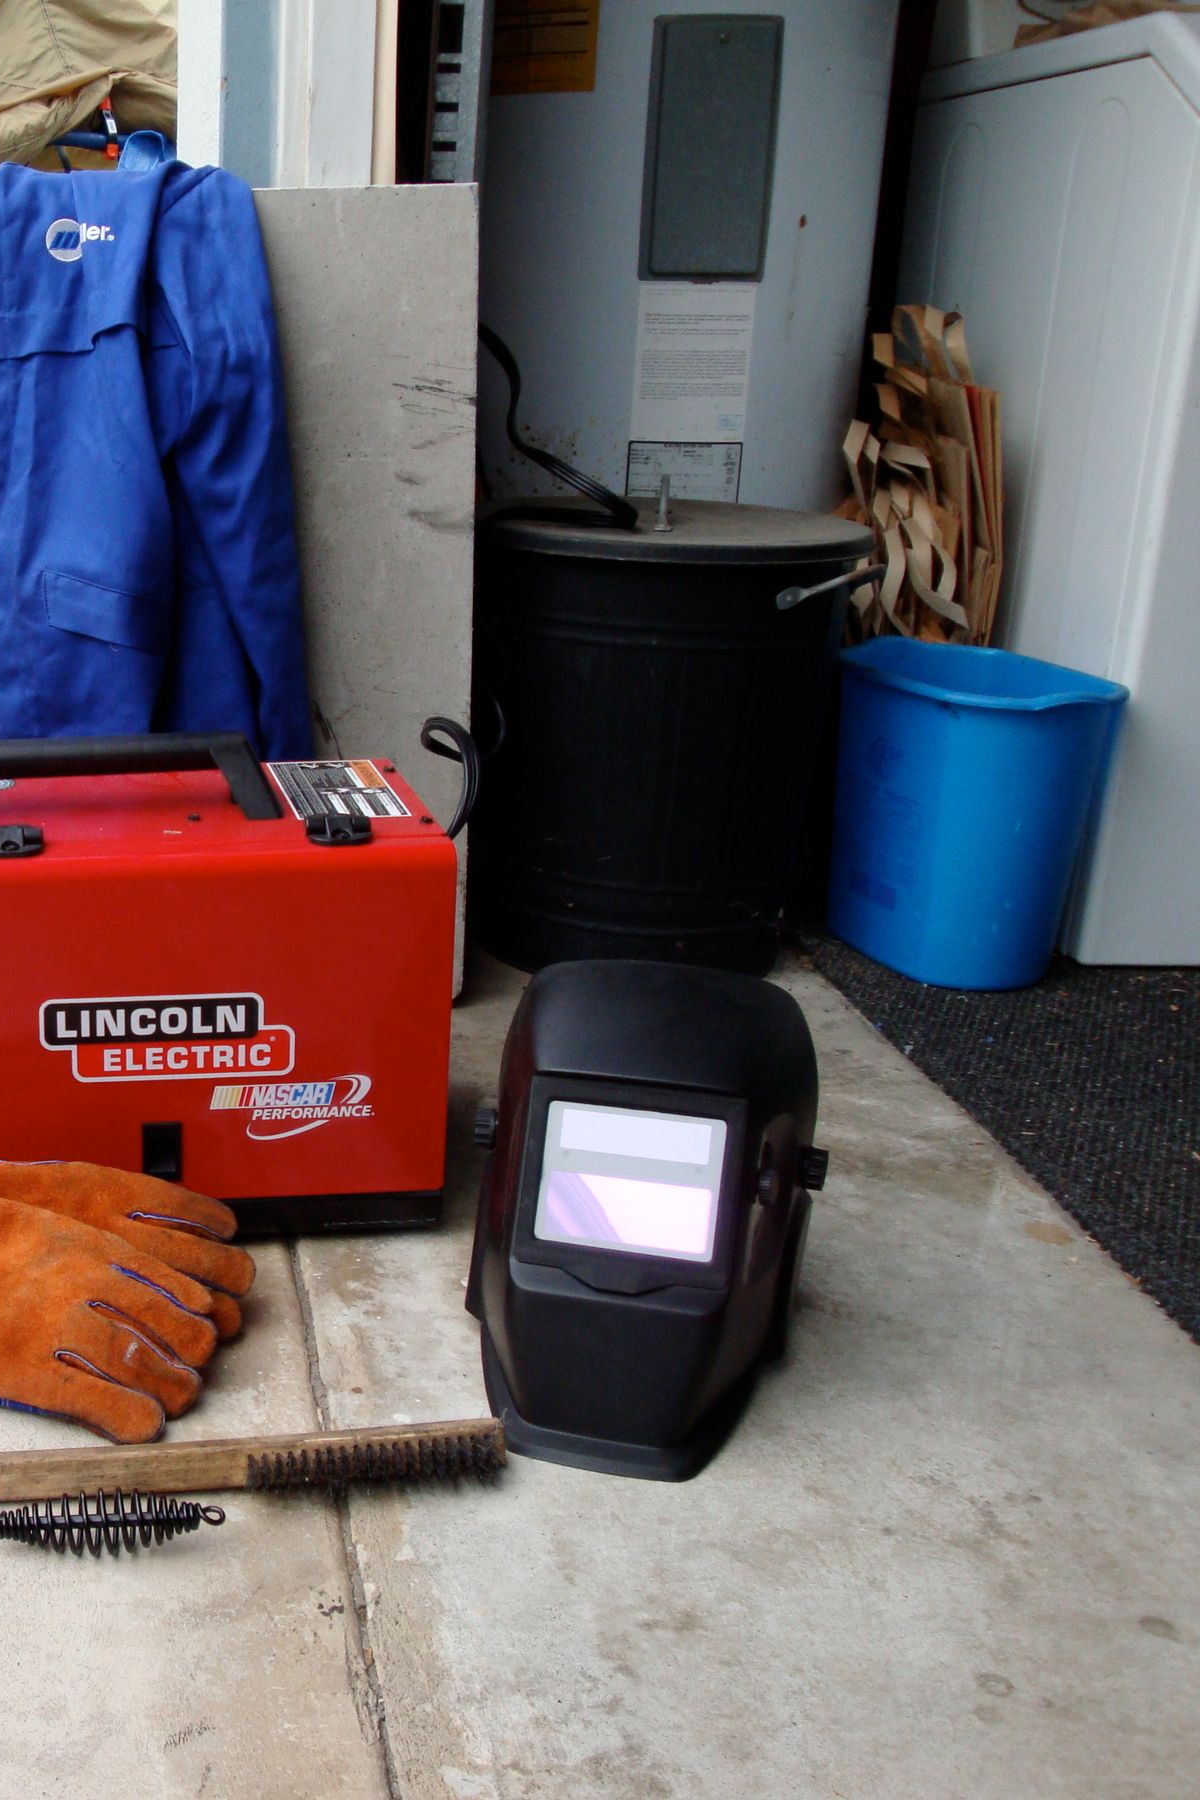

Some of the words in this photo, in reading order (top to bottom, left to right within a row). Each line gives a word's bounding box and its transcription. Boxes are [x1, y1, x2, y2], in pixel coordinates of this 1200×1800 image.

[56, 1005, 246, 1038] LINCOLN
[103, 1043, 272, 1072] ELECTRIC
[250, 1082, 329, 1107] NASCAR
